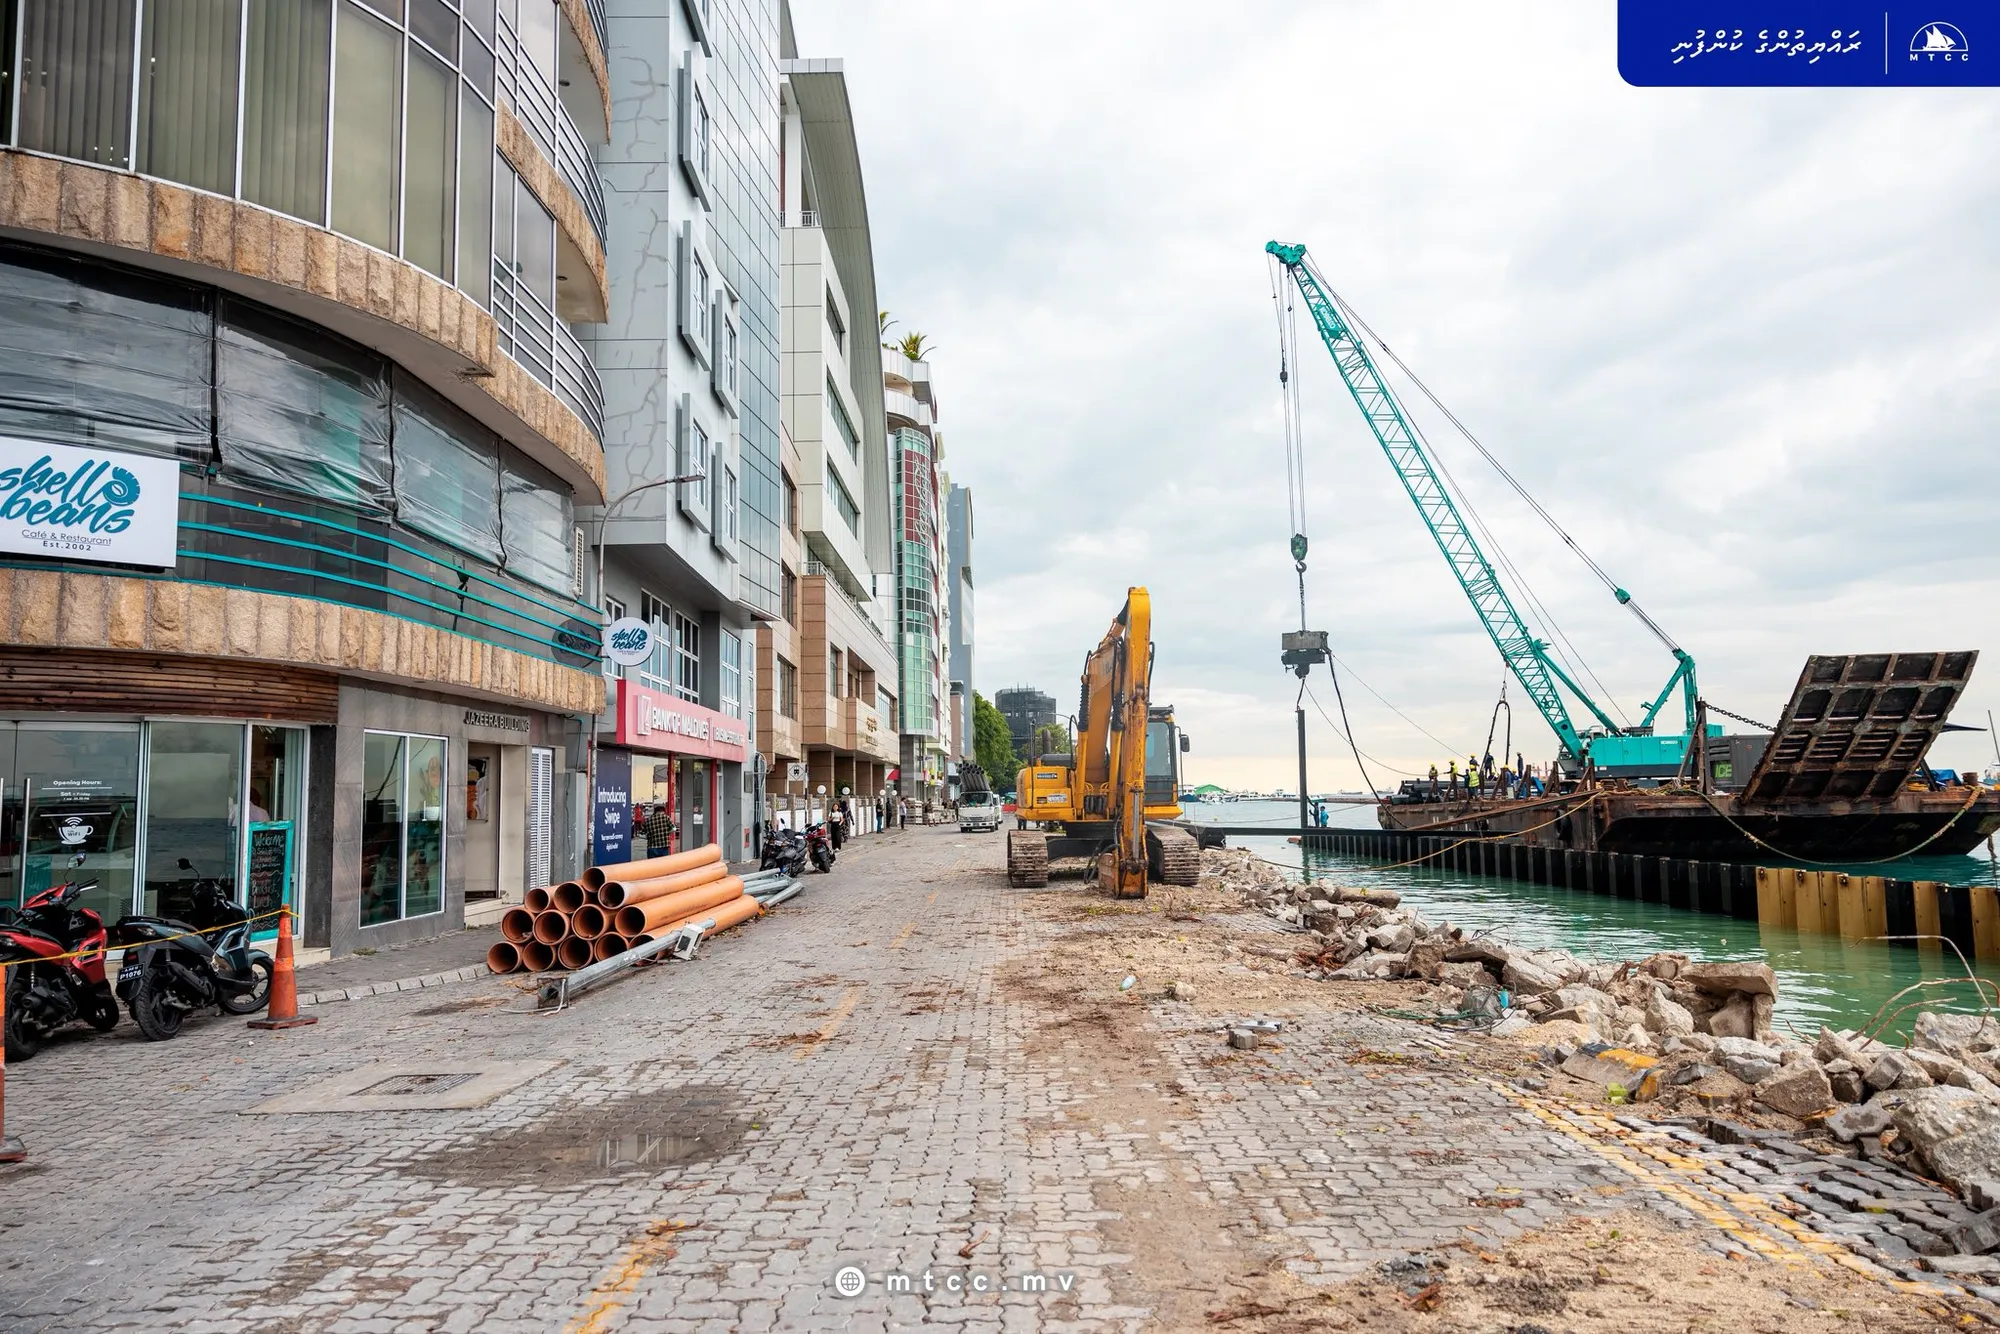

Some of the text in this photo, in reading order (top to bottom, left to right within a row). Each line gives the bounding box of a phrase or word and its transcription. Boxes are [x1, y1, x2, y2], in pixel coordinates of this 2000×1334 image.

[0, 455, 111, 507] shell
[0, 480, 134, 534] beans
[21, 529, 111, 546] Café & Restaurant
[611, 628, 640, 642] shell
[612, 639, 646, 651] beans
[463, 711, 530, 732] JAZEERA BUILDING
[652, 707, 670, 733] BANK
[1715, 764, 1732, 778] ICE
[598, 786, 626, 808] Introducing
[604, 807, 620, 829] Swipe
[120, 970, 141, 980] P1076
